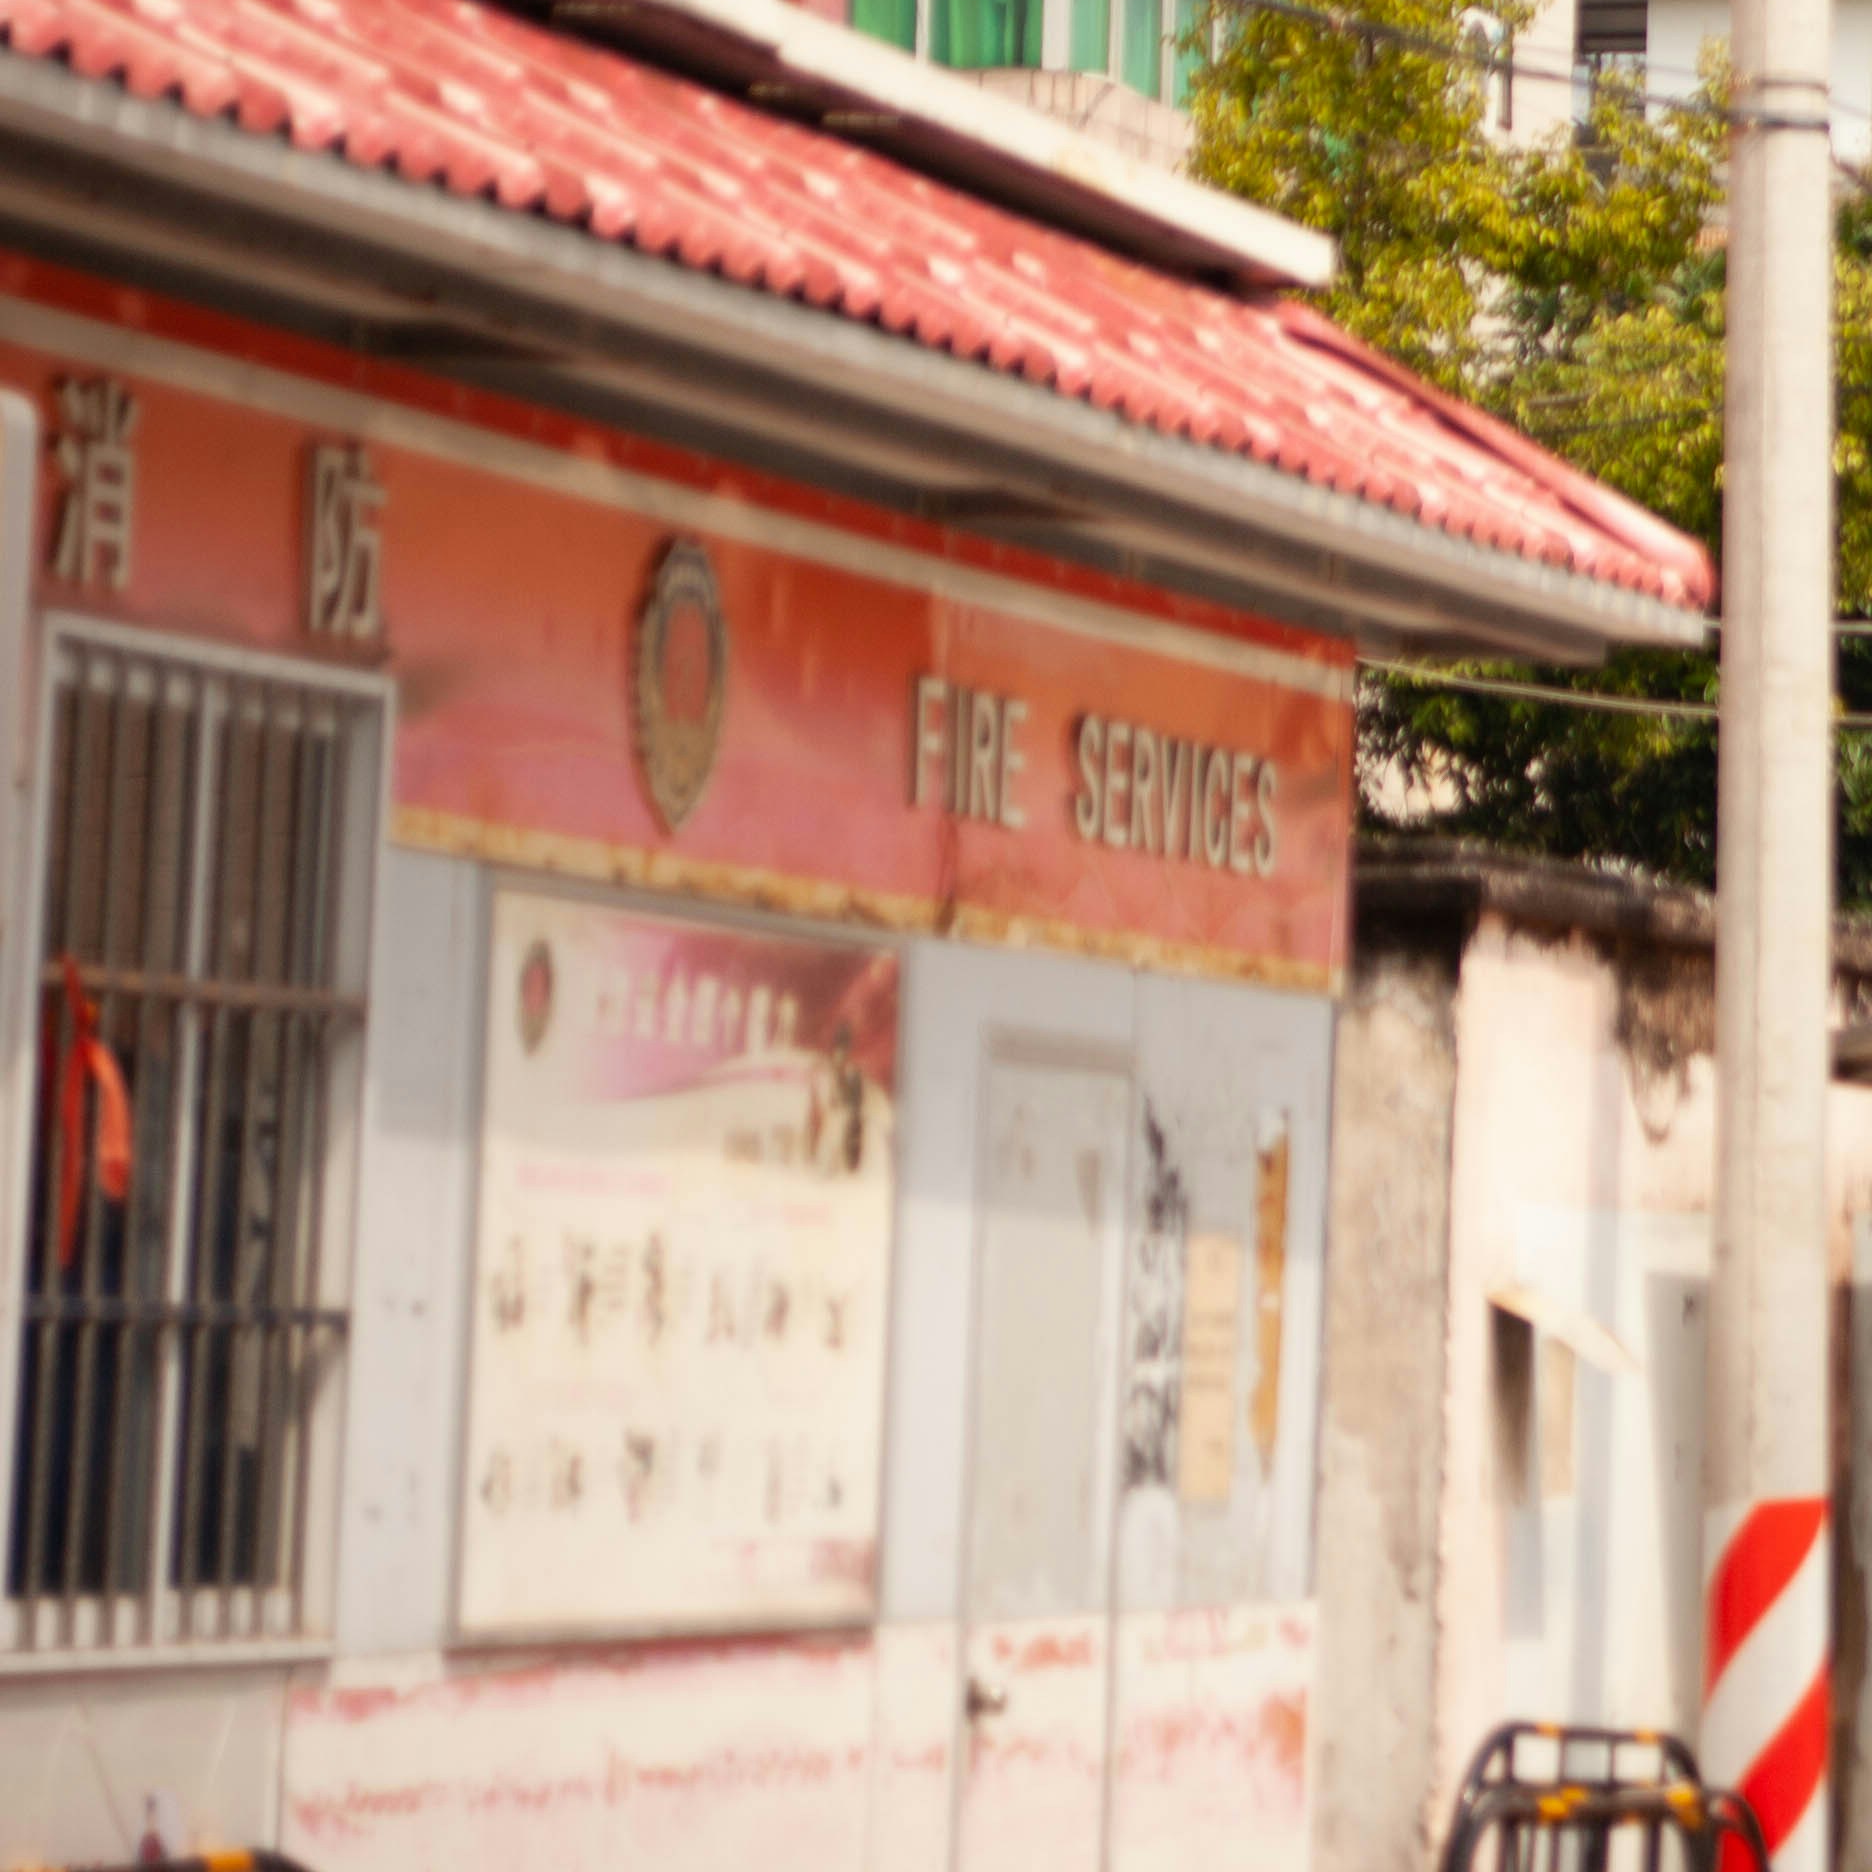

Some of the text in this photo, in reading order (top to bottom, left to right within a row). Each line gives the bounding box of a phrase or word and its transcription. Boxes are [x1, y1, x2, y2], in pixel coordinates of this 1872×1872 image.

[54, 376, 390, 640] 消防
[908, 674, 1279, 878] FIRE SERVICES
